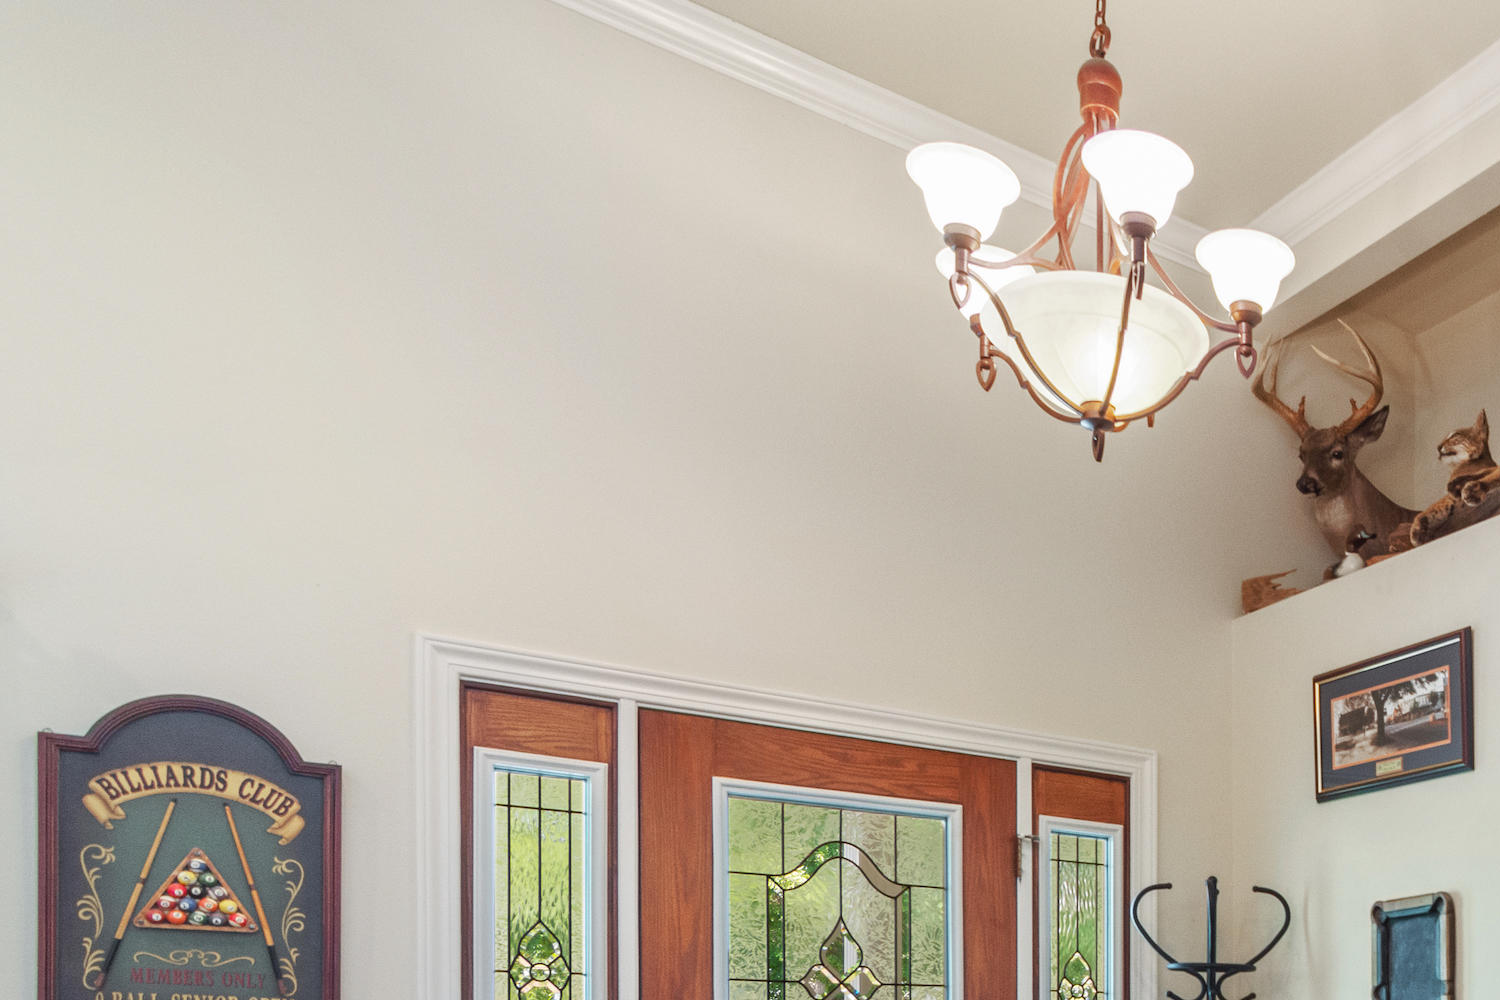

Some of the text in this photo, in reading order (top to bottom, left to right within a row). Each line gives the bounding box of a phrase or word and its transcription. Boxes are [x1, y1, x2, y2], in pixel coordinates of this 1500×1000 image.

[96, 764, 295, 817] BILLIARDS CLUB
[130, 967, 267, 989] MEMBERS ONLY
